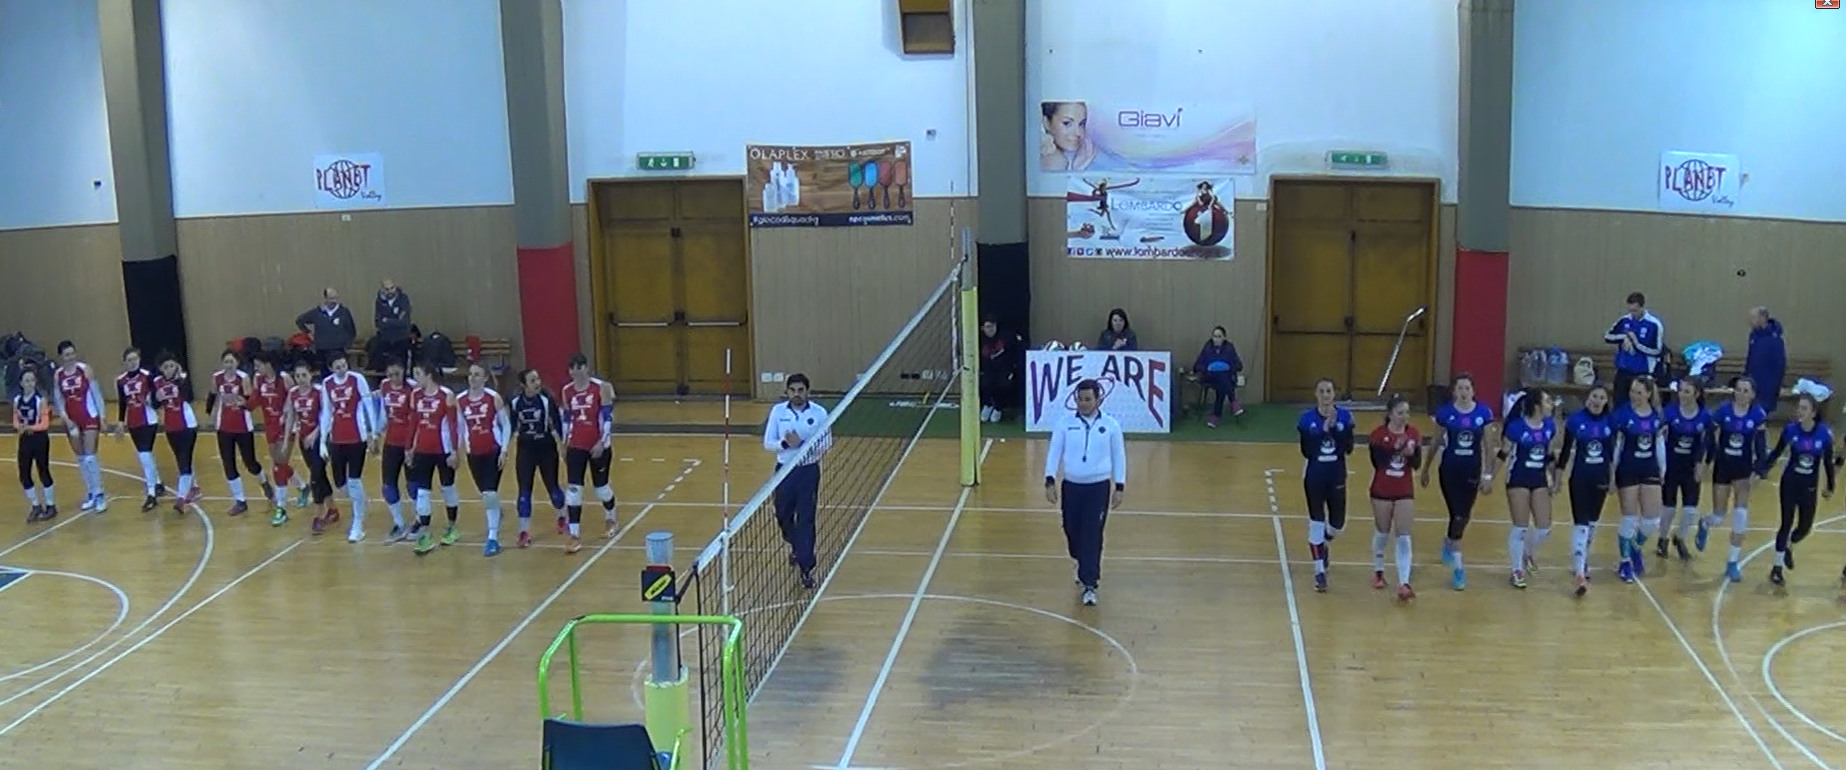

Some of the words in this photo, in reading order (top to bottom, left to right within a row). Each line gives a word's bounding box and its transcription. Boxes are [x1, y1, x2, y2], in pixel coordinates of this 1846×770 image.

[1118, 107, 1184, 128] Giavi
[749, 148, 809, 160] OLAPLEX
[316, 165, 371, 192] PLANET
[1665, 165, 1726, 192] PLANET
[1030, 355, 1084, 425] WE
[1101, 354, 1166, 428] ARE
